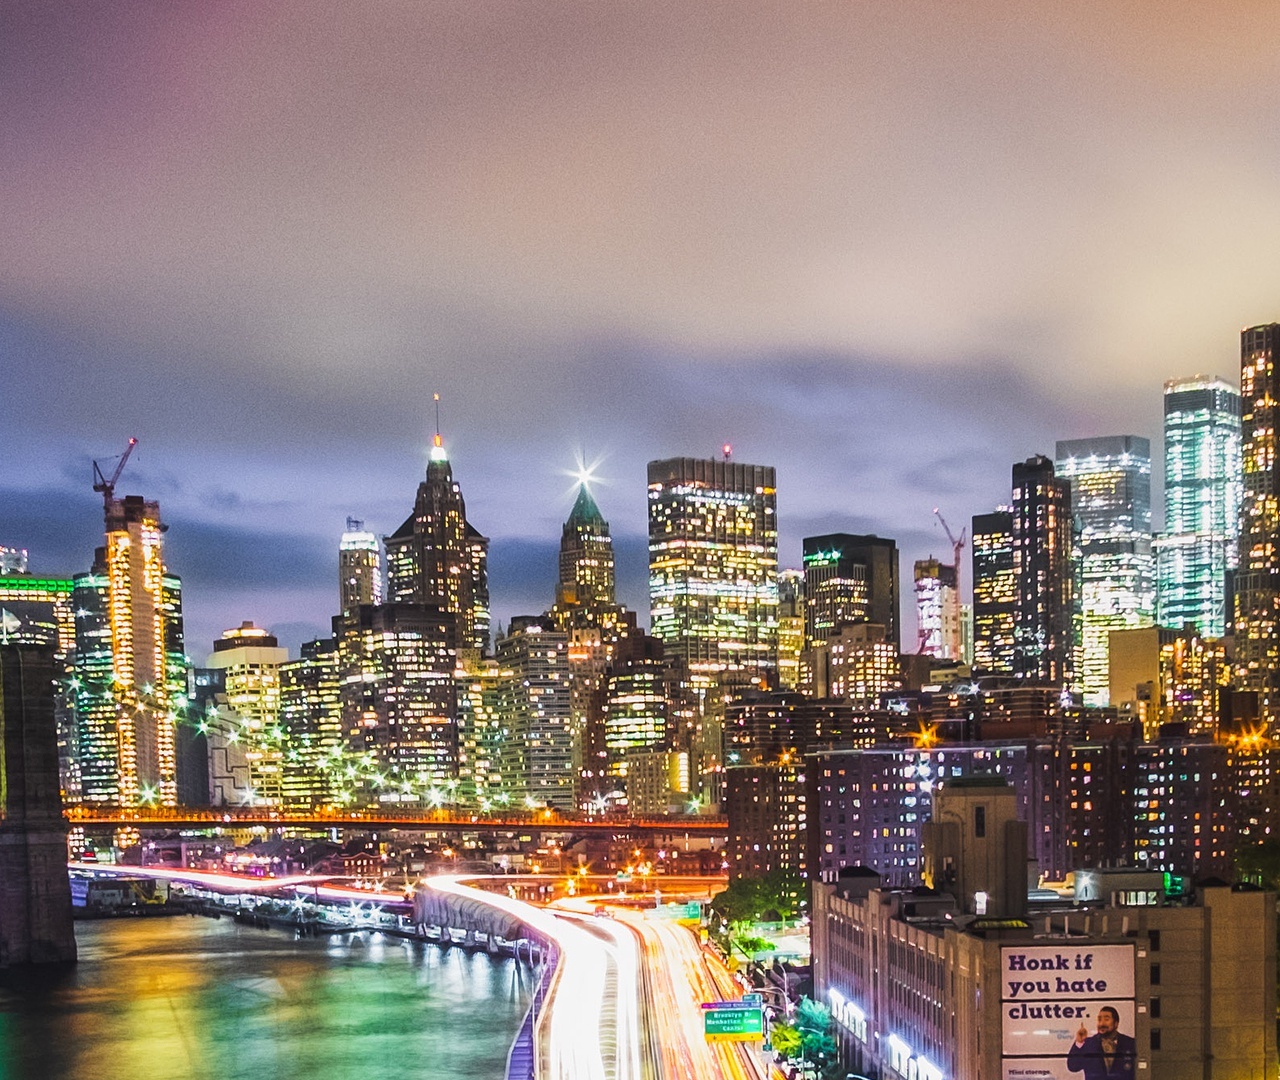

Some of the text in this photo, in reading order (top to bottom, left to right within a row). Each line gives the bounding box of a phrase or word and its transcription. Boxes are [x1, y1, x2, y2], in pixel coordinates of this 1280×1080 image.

[1008, 954, 1093, 971] Honk if
[1008, 977, 1107, 997] you hate
[1009, 1004, 1090, 1019] clutter.
